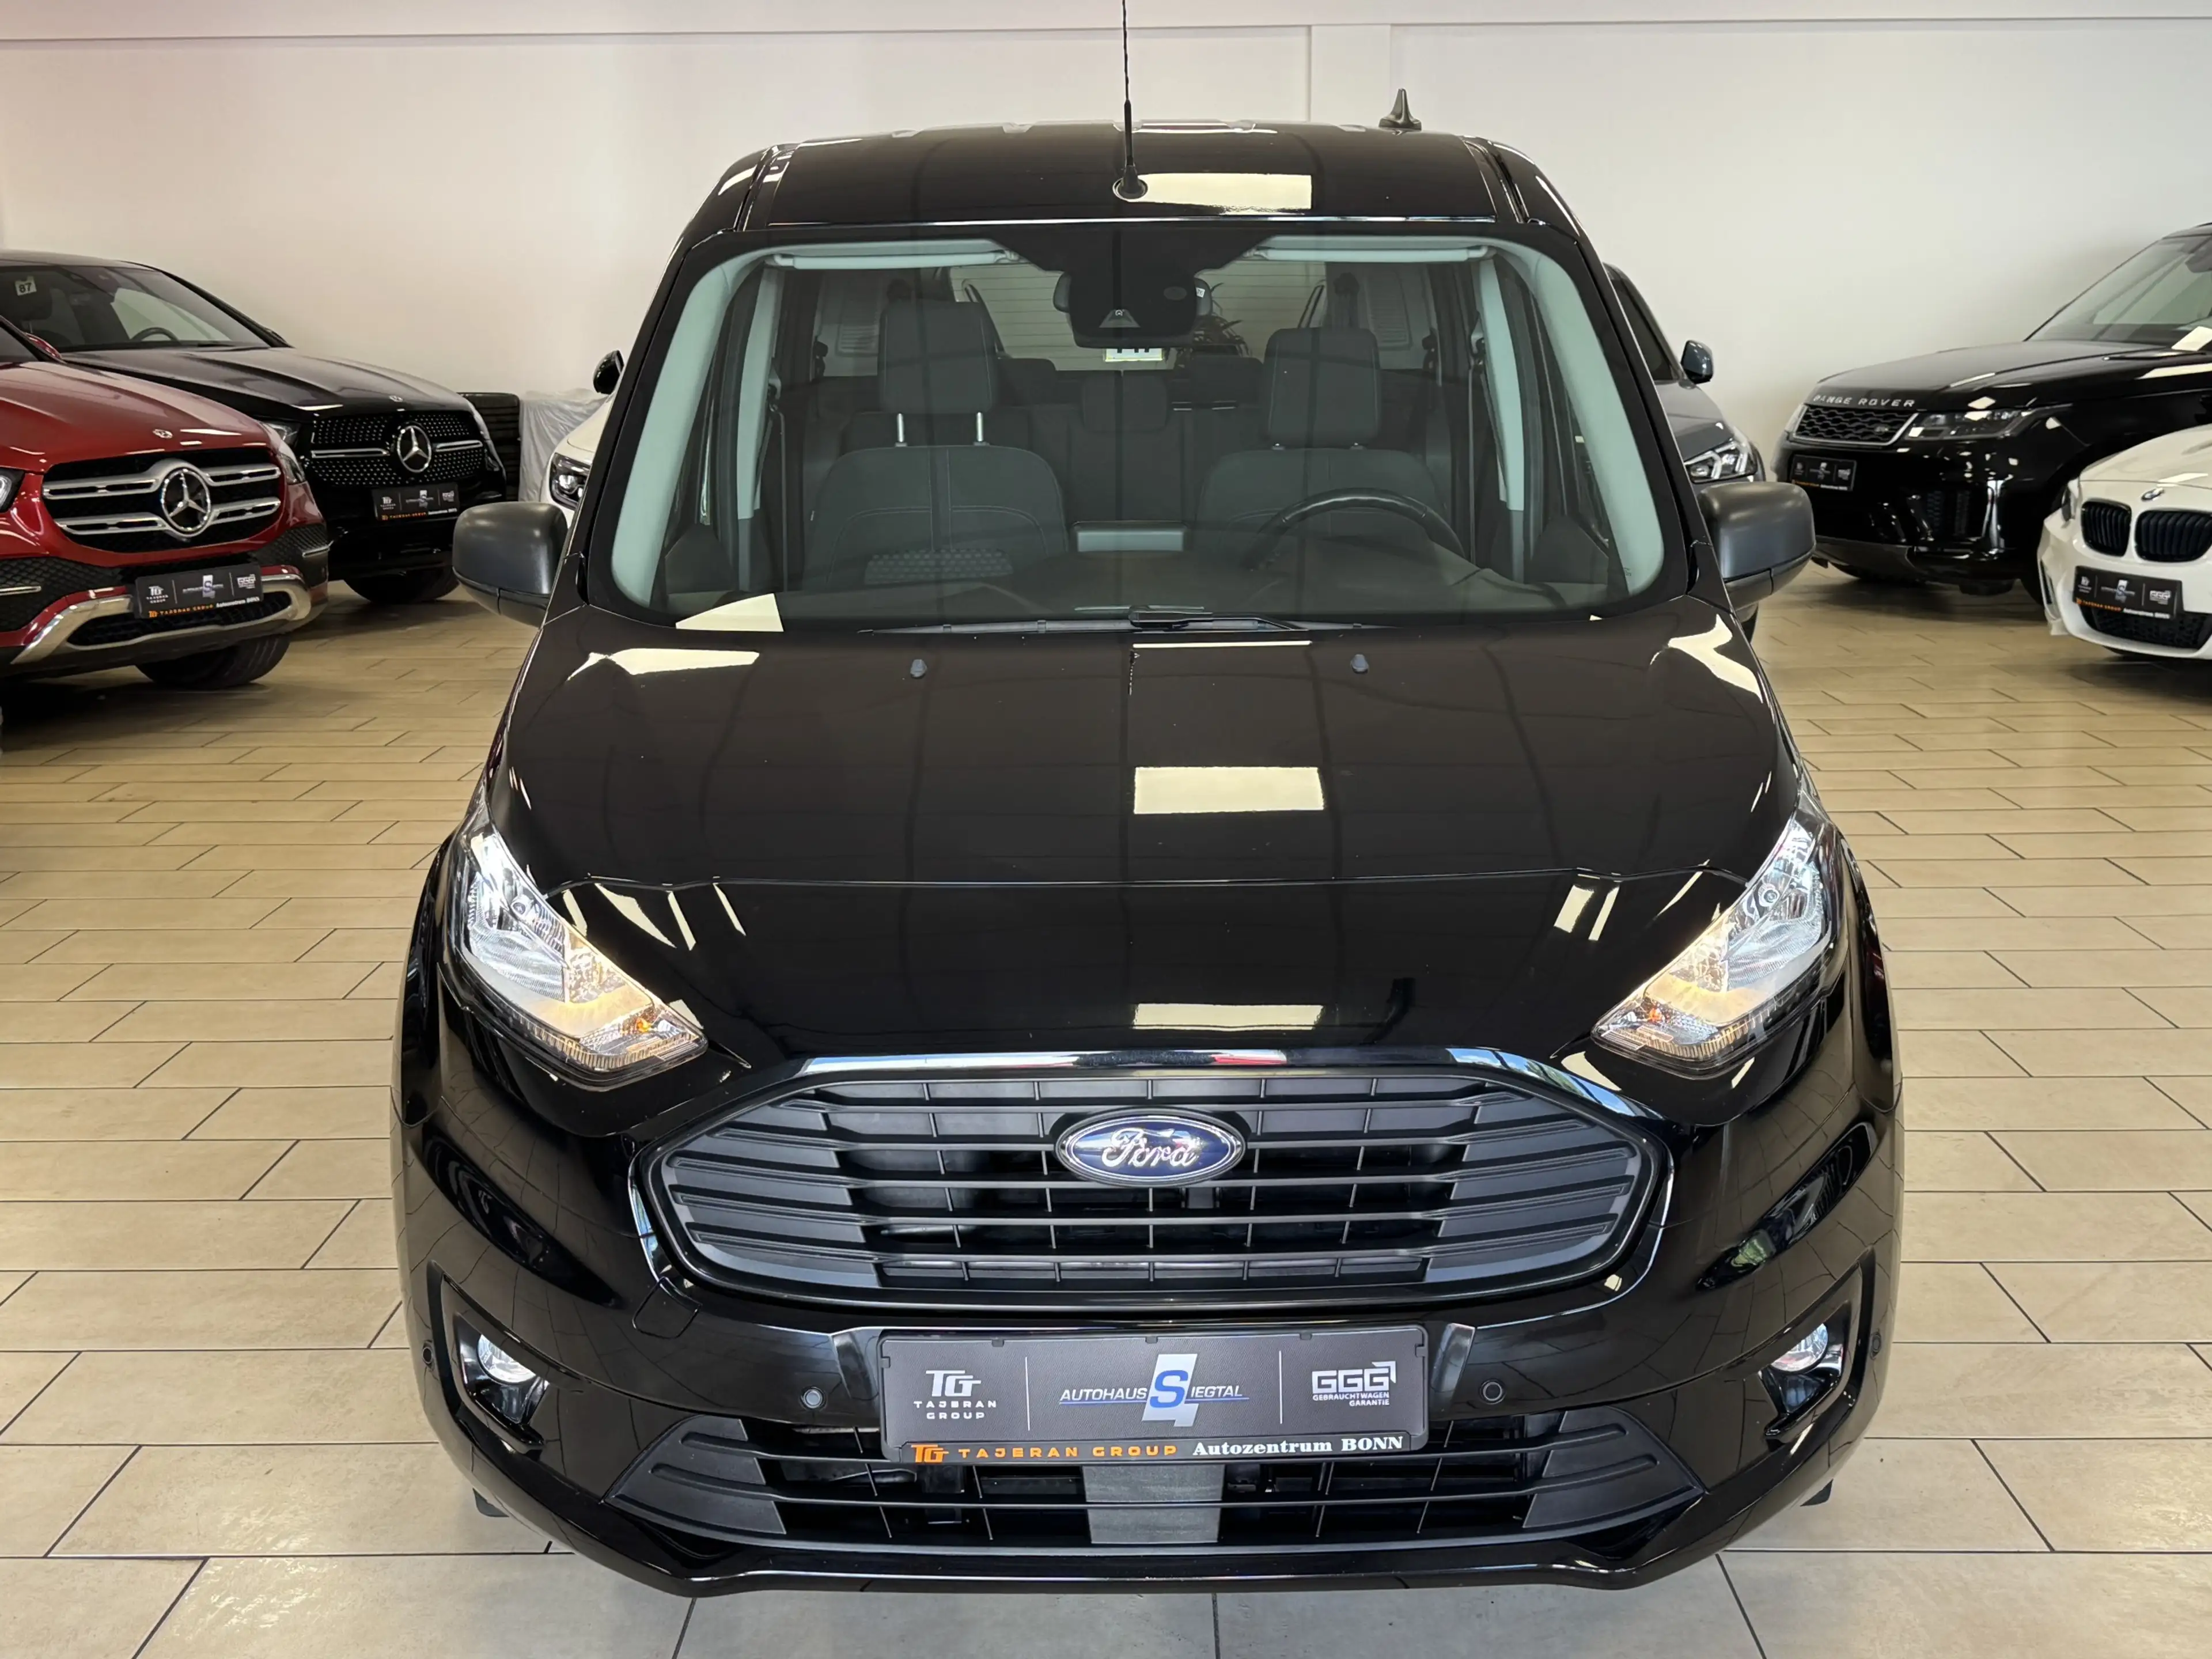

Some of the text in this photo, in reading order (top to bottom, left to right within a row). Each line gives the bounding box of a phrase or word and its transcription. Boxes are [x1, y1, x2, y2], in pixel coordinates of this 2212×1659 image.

[18, 282, 31, 293] 87
[1813, 394, 1915, 407] RANGE ROVER
[1101, 1128, 1202, 1167] Ford
[926, 1370, 982, 1397] TG
[1312, 1368, 1389, 1394] GGG
[1060, 1388, 1148, 1401] AUTOHAUS
[1312, 1392, 1389, 1401] GEBRAUCHTWAGEN
[913, 1400, 997, 1408] TAJERAN
[1349, 1399, 1390, 1407] GARANTIE
[911, 1436, 1404, 1463] TG TAJERAN GROUP Autozentrum BONN
